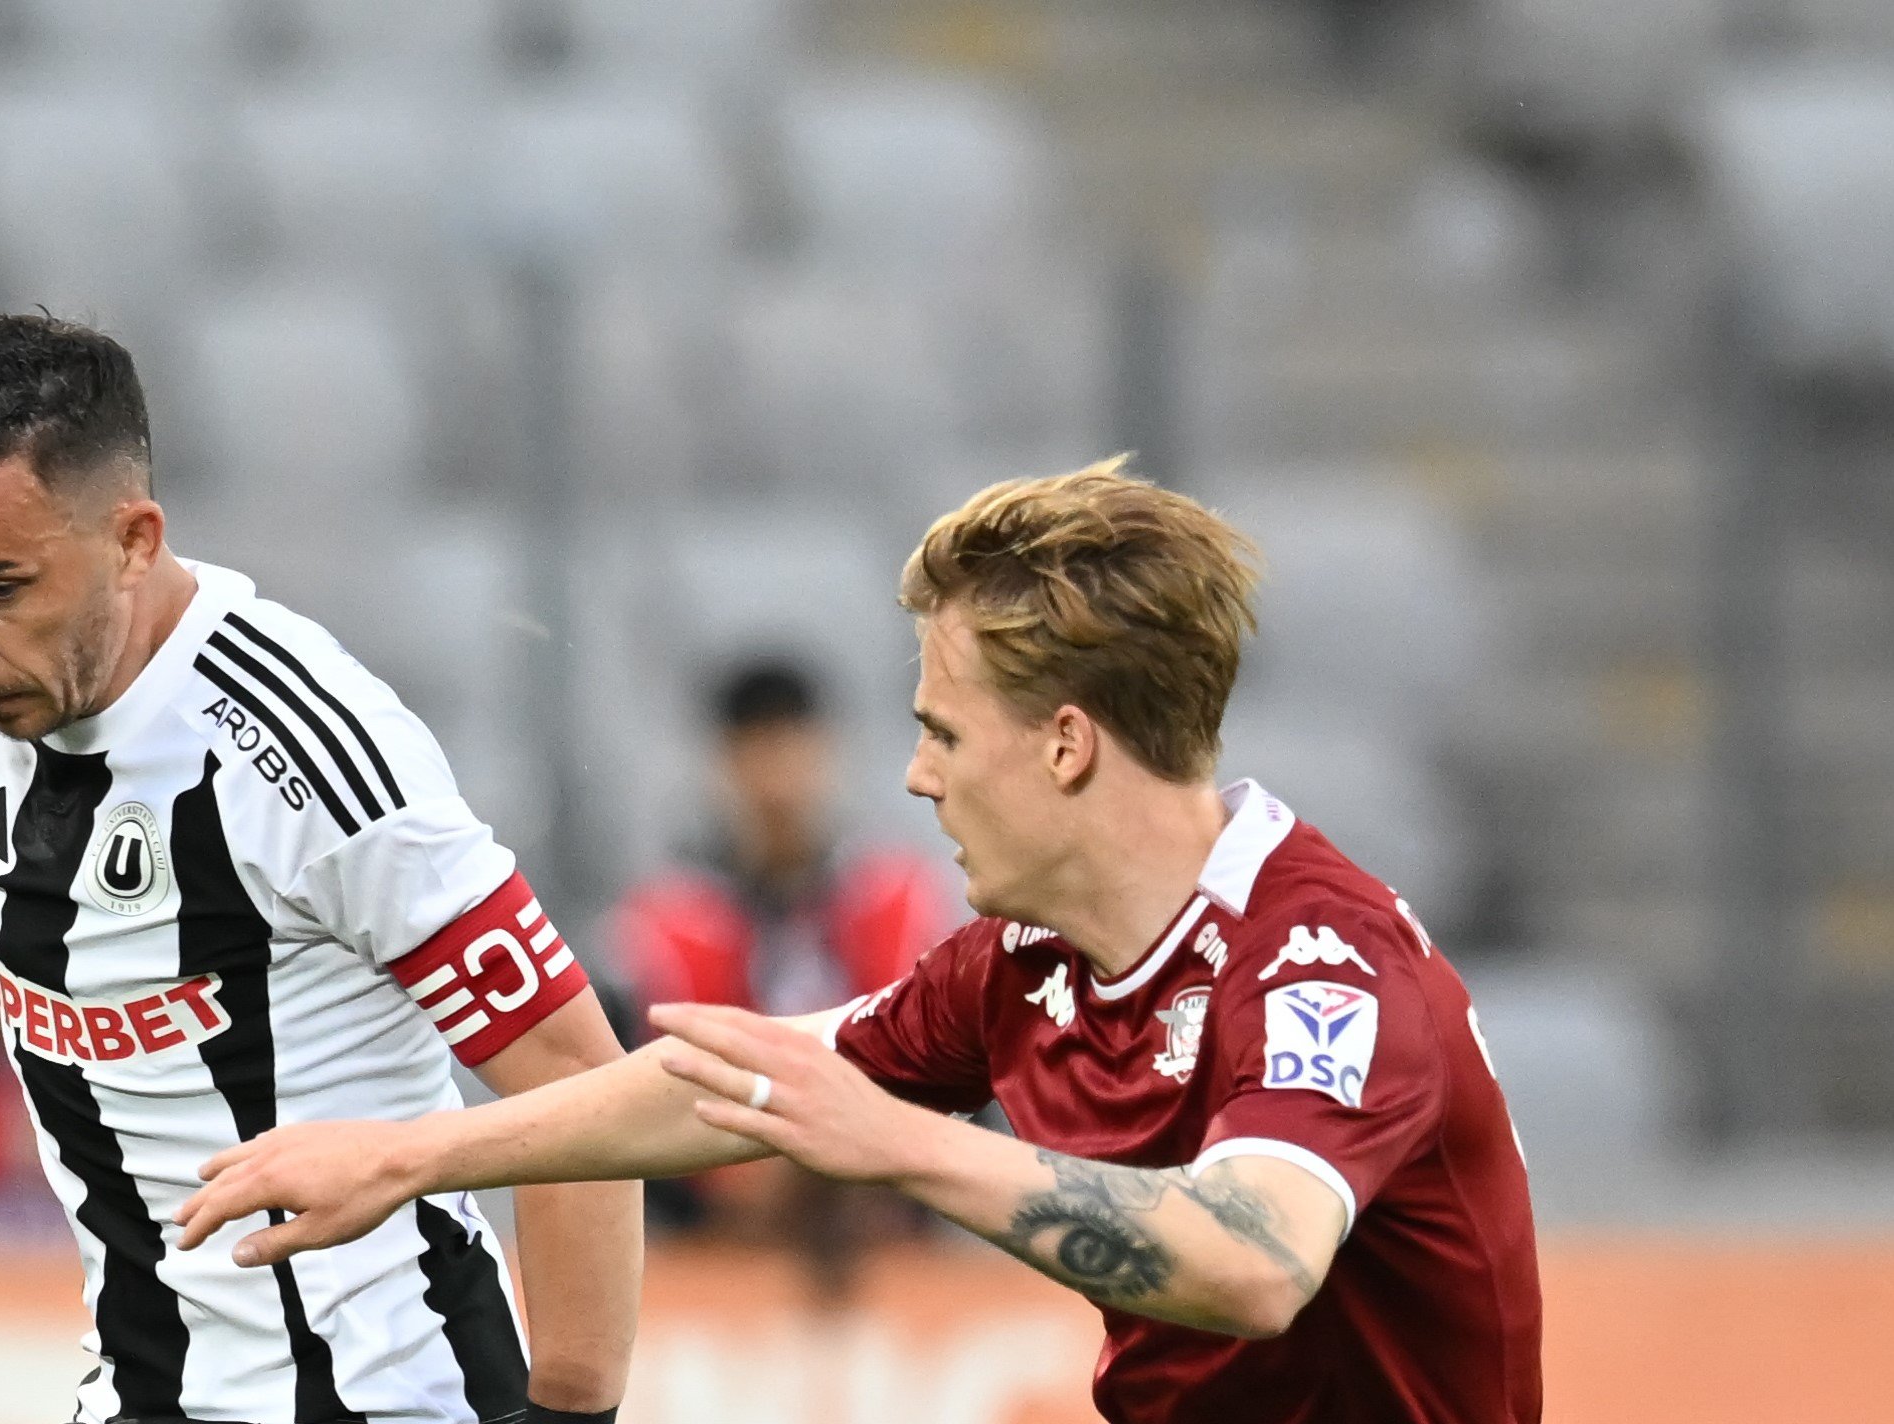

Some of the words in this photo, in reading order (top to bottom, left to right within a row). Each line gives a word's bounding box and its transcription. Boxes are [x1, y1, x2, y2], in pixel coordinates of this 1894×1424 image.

[203, 696, 313, 813] AROBS
[104, 834, 143, 891] U
[110, 901, 142, 913] 1919
[1270, 1050, 1363, 1108] DSC
